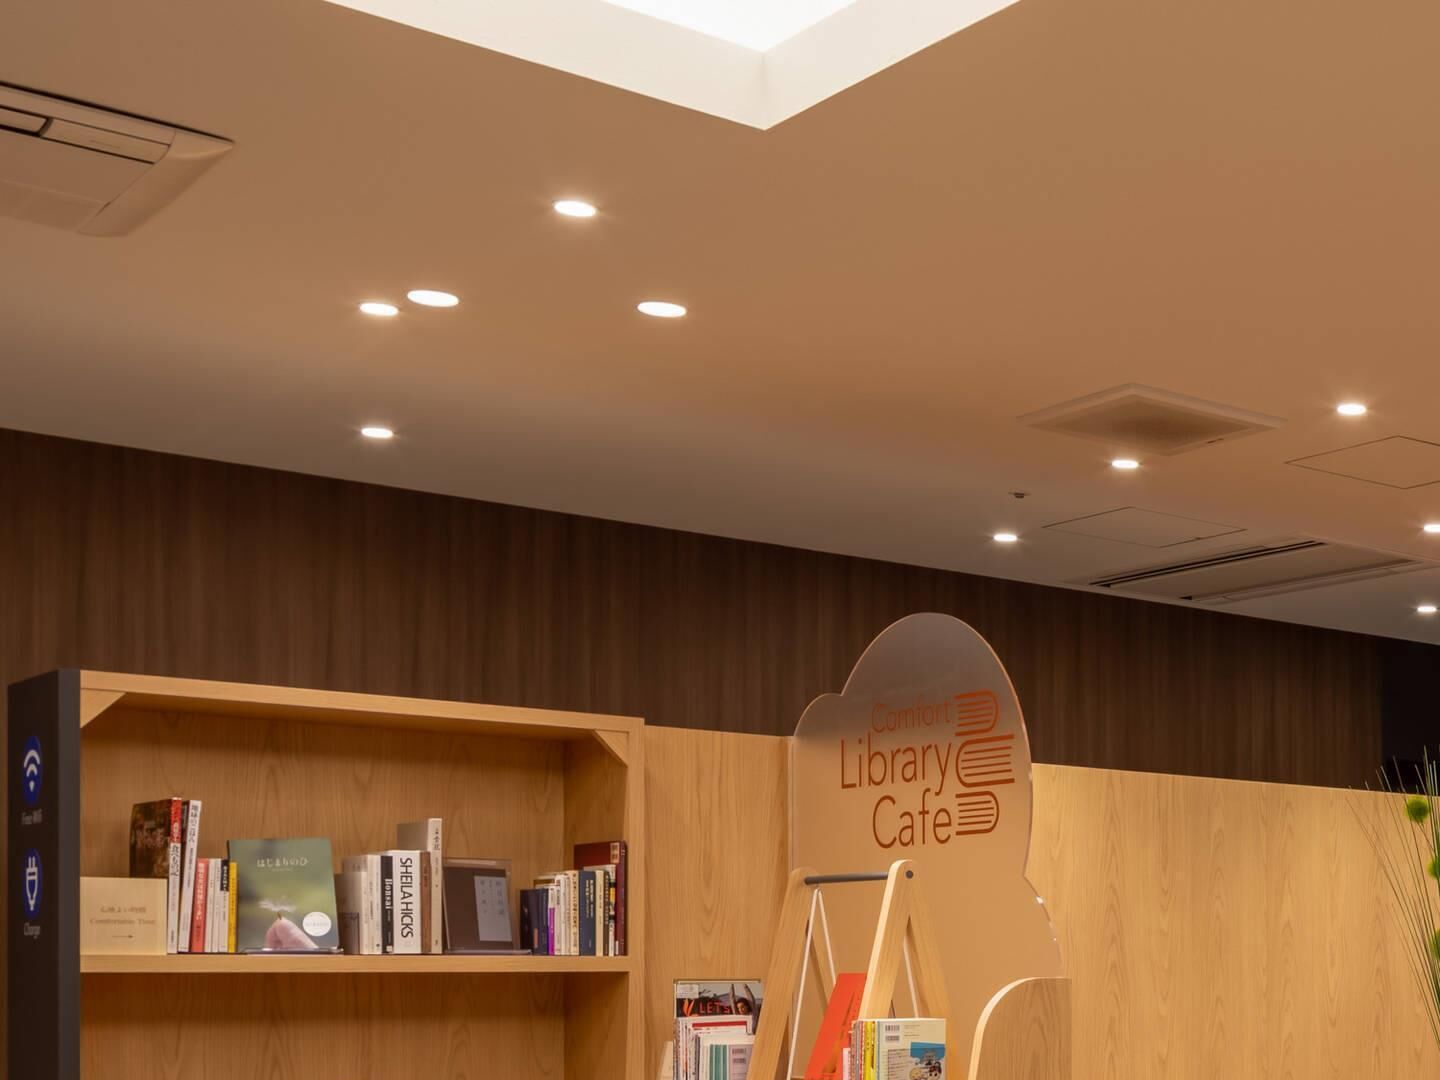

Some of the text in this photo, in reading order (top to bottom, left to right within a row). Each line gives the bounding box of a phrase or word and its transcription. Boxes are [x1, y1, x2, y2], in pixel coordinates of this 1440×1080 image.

[871, 698, 952, 735] Comfort
[841, 730, 952, 797] Library
[873, 788, 952, 849] Cafe
[399, 857, 414, 938] SHEILA HICKS
